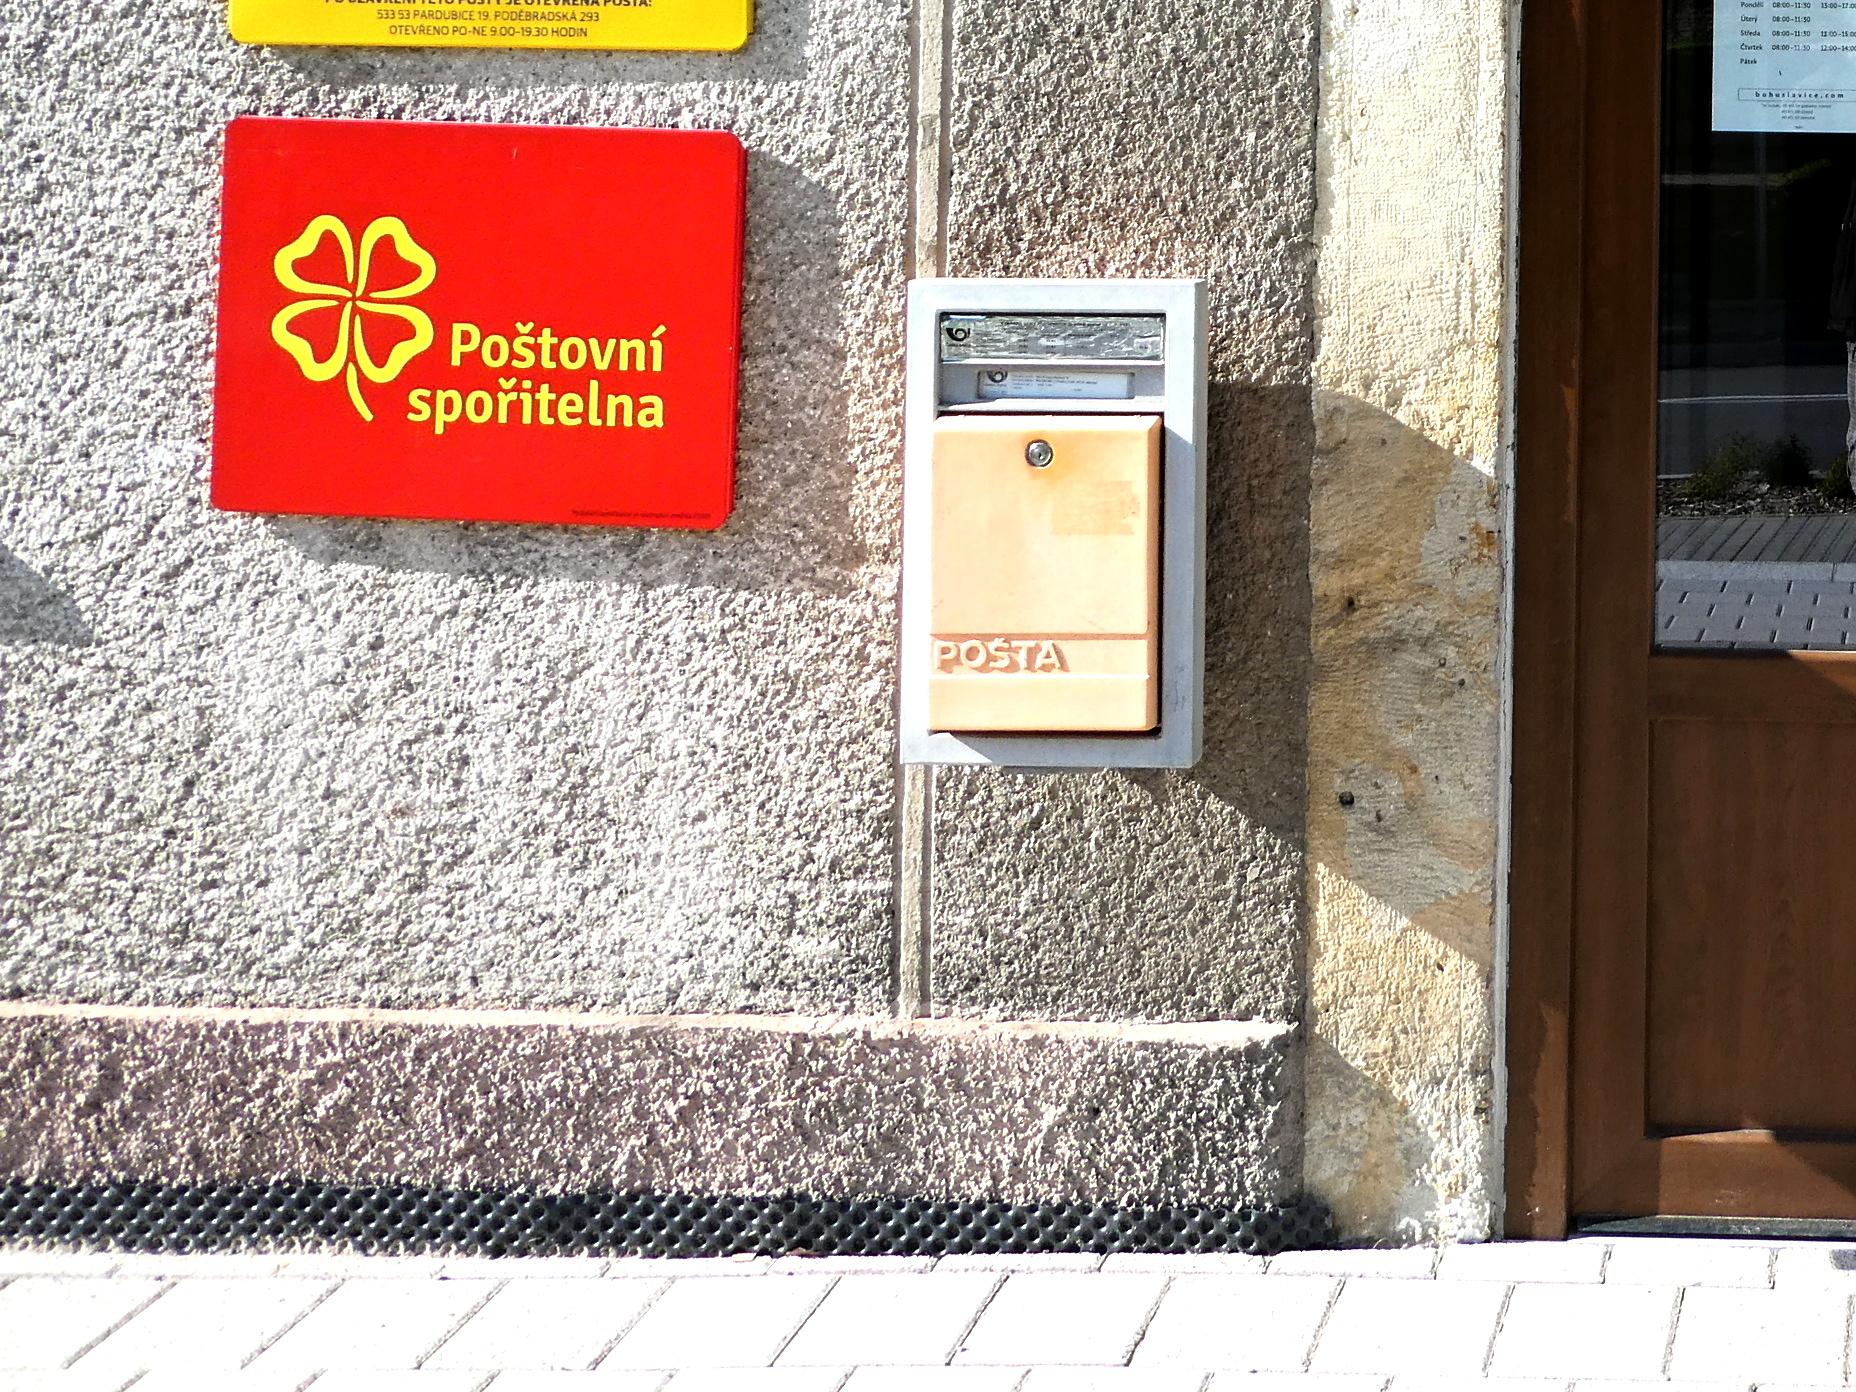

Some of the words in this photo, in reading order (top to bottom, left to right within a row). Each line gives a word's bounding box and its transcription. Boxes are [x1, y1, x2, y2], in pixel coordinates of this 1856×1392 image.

[377, 10, 395, 20] 533
[398, 10, 410, 20] 53
[413, 10, 474, 21] PARDUBICE
[494, 10, 577, 22] PODĚBRADSKÁ
[579, 12, 599, 22] 293
[390, 24, 448, 35] OTEVŘENO
[452, 26, 487, 36] PO-NE
[551, 27, 587, 38] HODIN
[451, 321, 667, 372] Poštovní
[407, 378, 665, 435] spořitelna
[934, 637, 1062, 670] POŠTA
